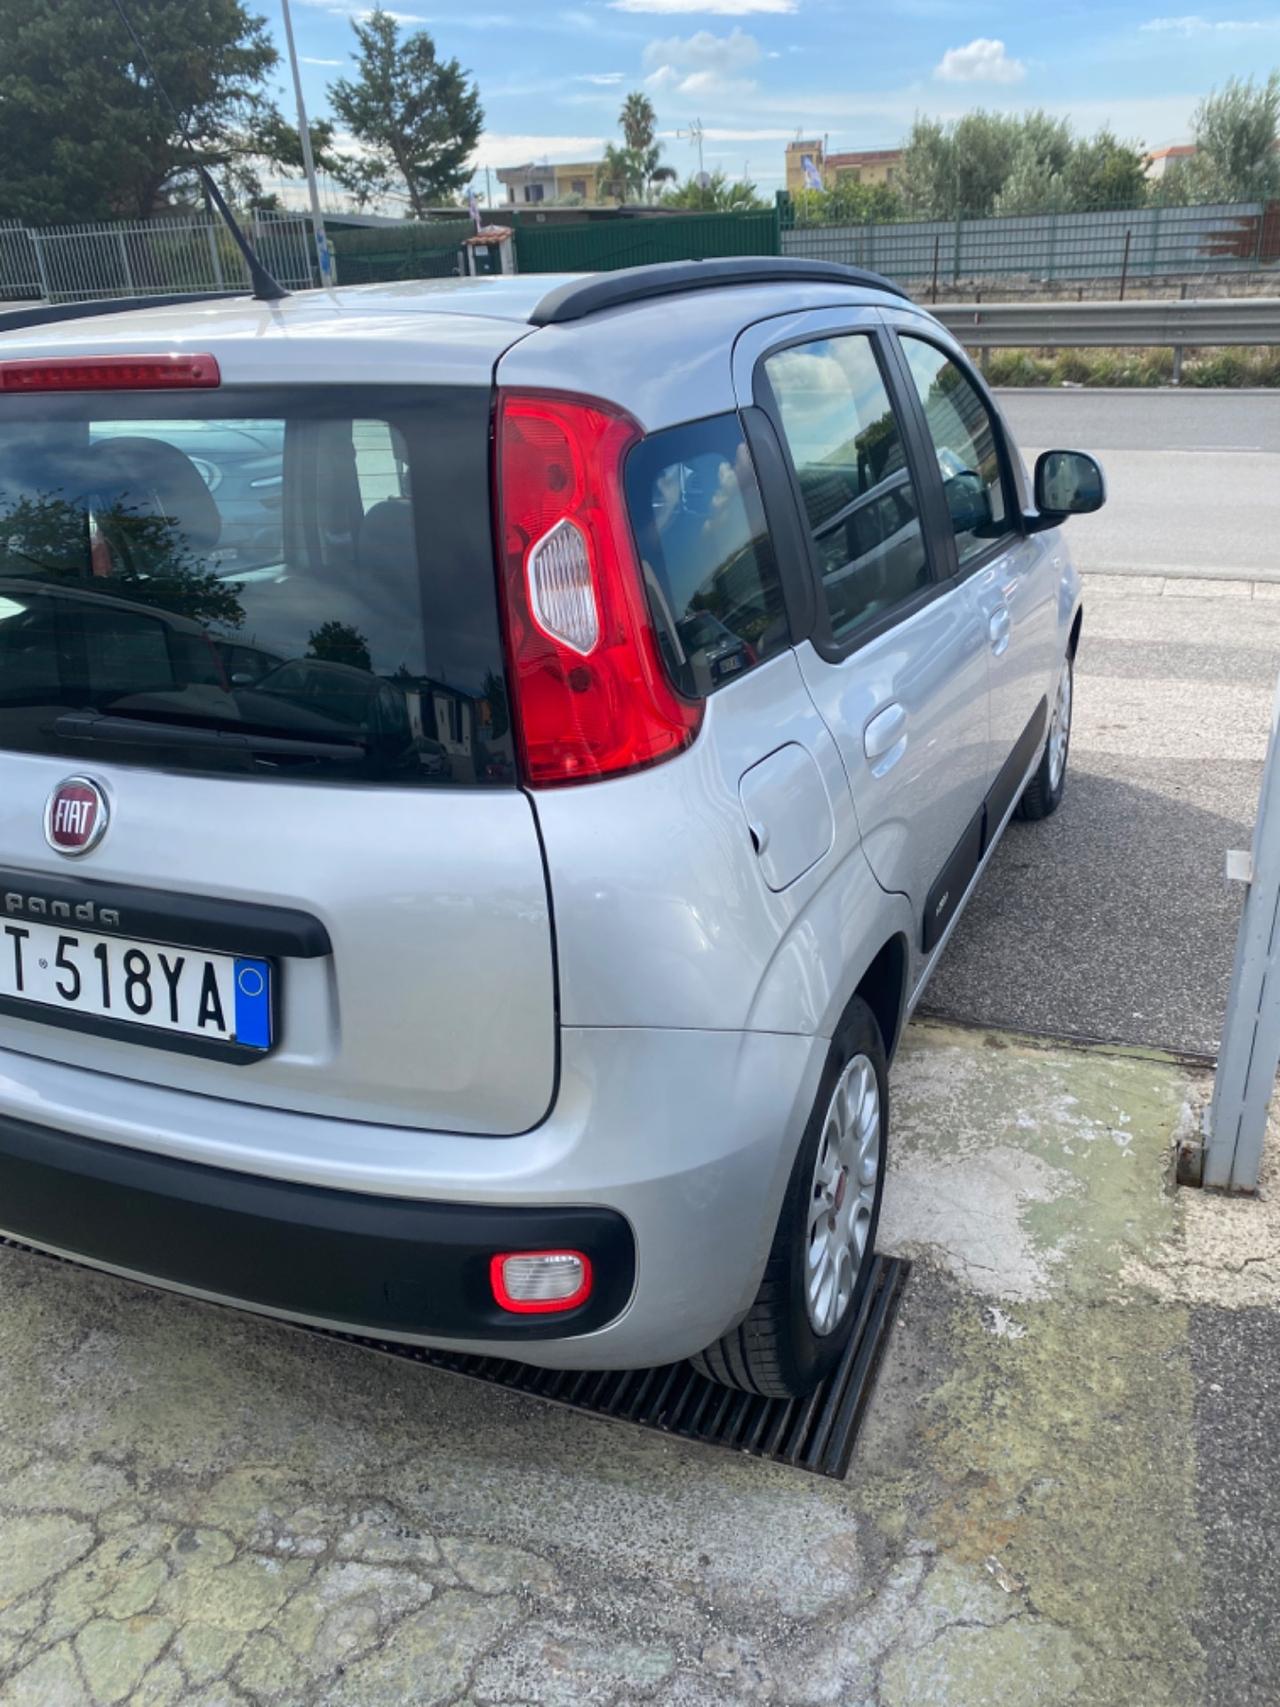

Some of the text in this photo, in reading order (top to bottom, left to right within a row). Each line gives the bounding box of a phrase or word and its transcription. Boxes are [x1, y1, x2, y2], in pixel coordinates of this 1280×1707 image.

[55, 799, 93, 834] FIAT
[5, 892, 119, 926] panda
[55, 935, 226, 1032] 518YA
